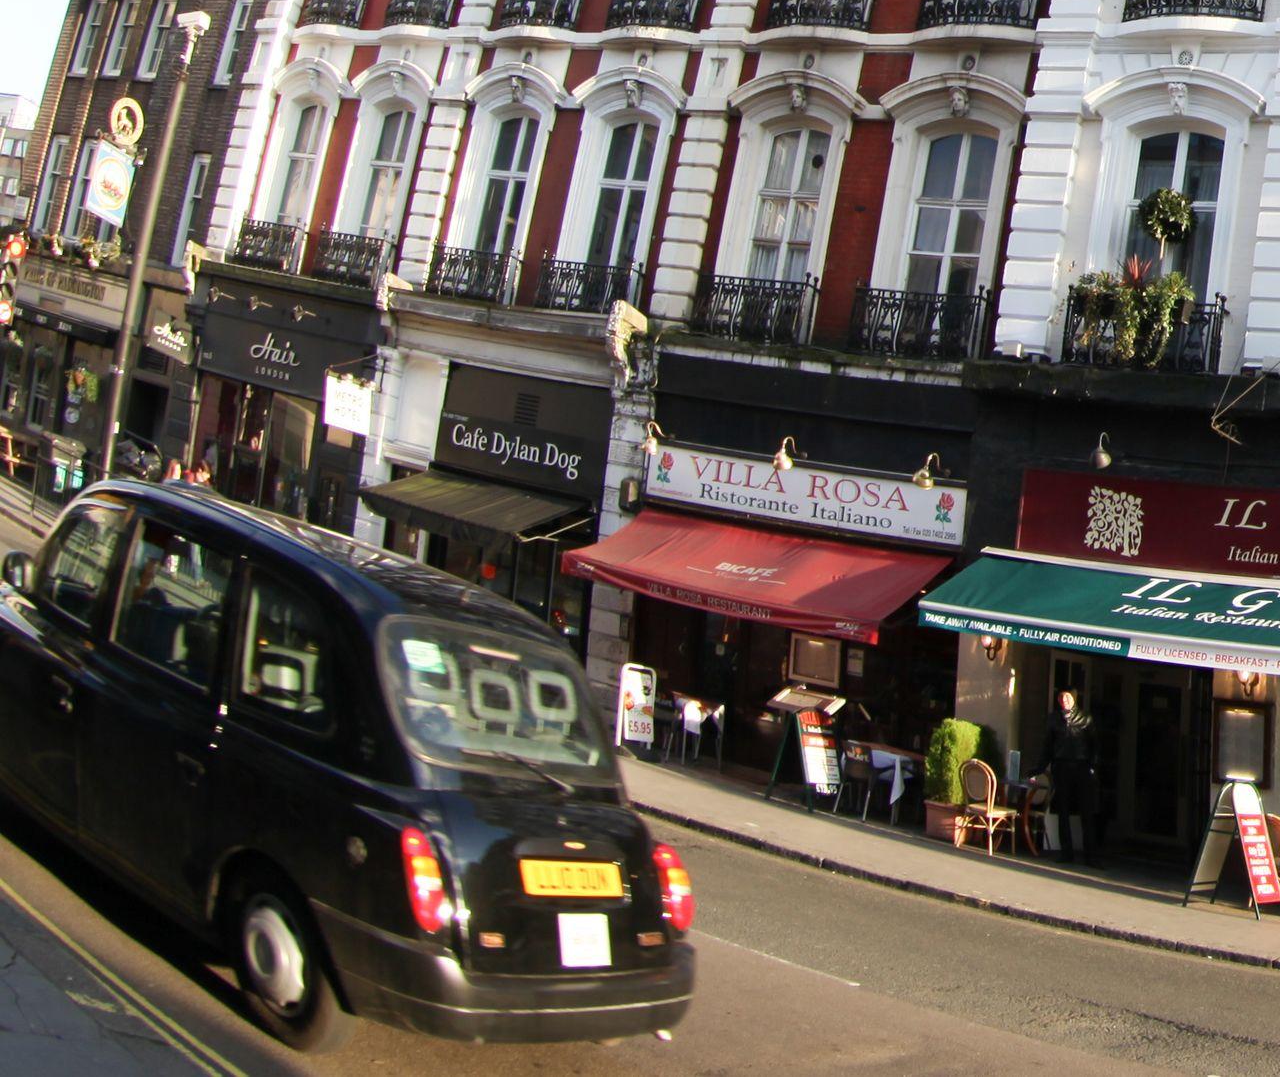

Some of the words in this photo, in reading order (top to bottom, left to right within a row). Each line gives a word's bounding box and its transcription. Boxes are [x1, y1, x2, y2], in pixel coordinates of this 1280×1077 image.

[250, 333, 300, 367] Hair
[255, 365, 291, 380] LONDON
[452, 423, 488, 451] Cafe
[491, 432, 540, 465] Dylan
[543, 443, 581, 480] Dog
[690, 455, 786, 494] VILLA
[806, 474, 910, 512] ROSA
[700, 483, 799, 514] Ristorante
[811, 502, 892, 529] Italiano
[1214, 498, 1267, 531] IL
[1227, 546, 1279, 566] Italian
[647, 582, 672, 597] VILLA
[676, 589, 702, 604] ROSA
[707, 596, 772, 619] RESTAURANT
[1121, 577, 1203, 604] IL
[1111, 603, 1190, 621] Italian
[924, 613, 946, 625] TAKE
[946, 616, 969, 629] AWAY
[968, 620, 1013, 637] AVAILABLE
[1019, 628, 1045, 640] FULLY
[1045, 631, 1060, 642] AIR
[1061, 634, 1122, 651] CONDITIONED
[1135, 644, 1163, 657] FULLY
[1164, 646, 1208, 662] LICENSED
[1215, 654, 1269, 668] BREAKFAST
